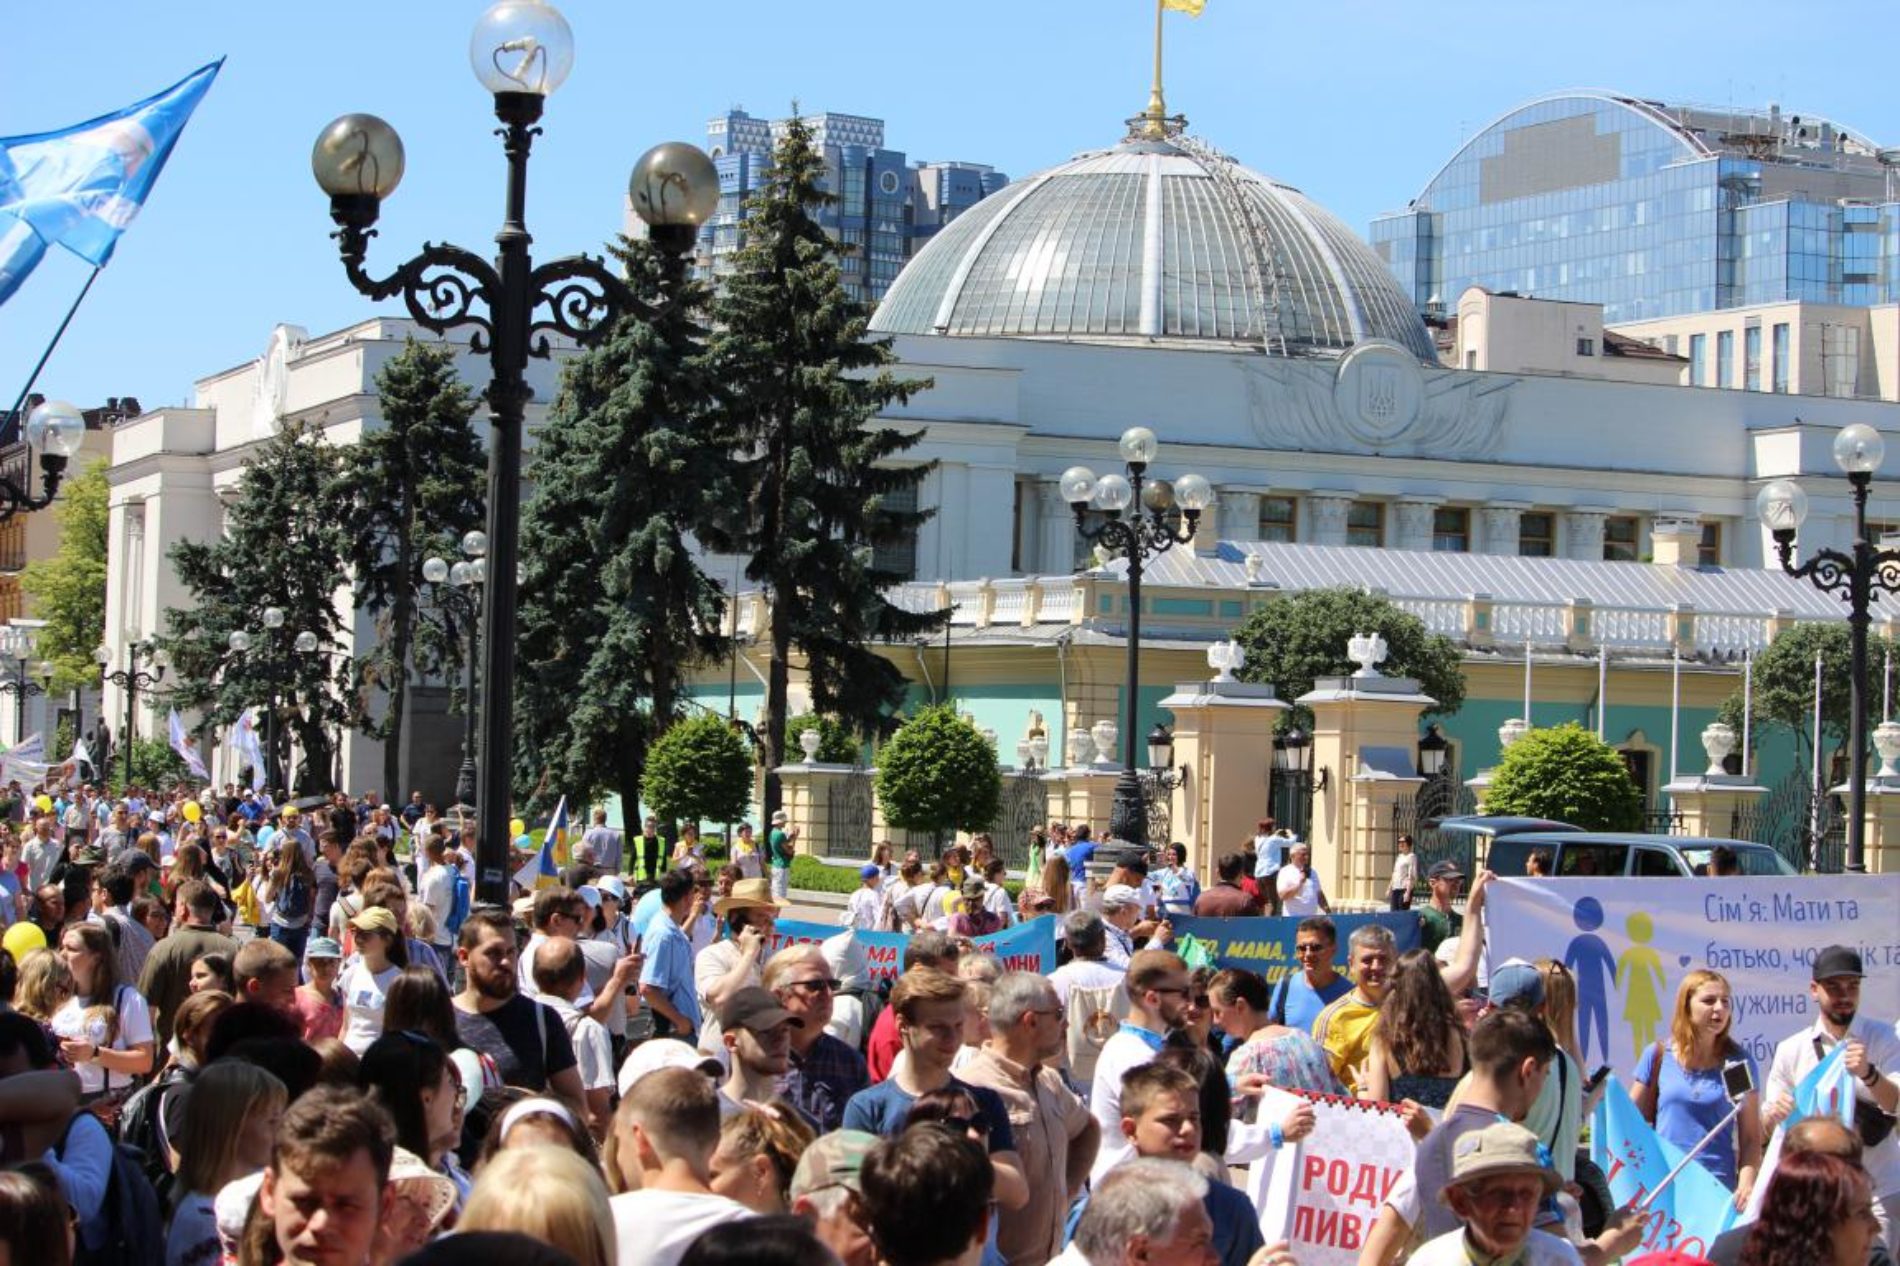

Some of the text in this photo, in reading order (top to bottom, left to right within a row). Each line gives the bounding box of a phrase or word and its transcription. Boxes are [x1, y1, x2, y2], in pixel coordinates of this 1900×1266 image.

[1704, 893, 1860, 923] Сім'я: Мати та
[1225, 941, 1287, 961] МАМА,
[1705, 940, 1789, 972] батько,
